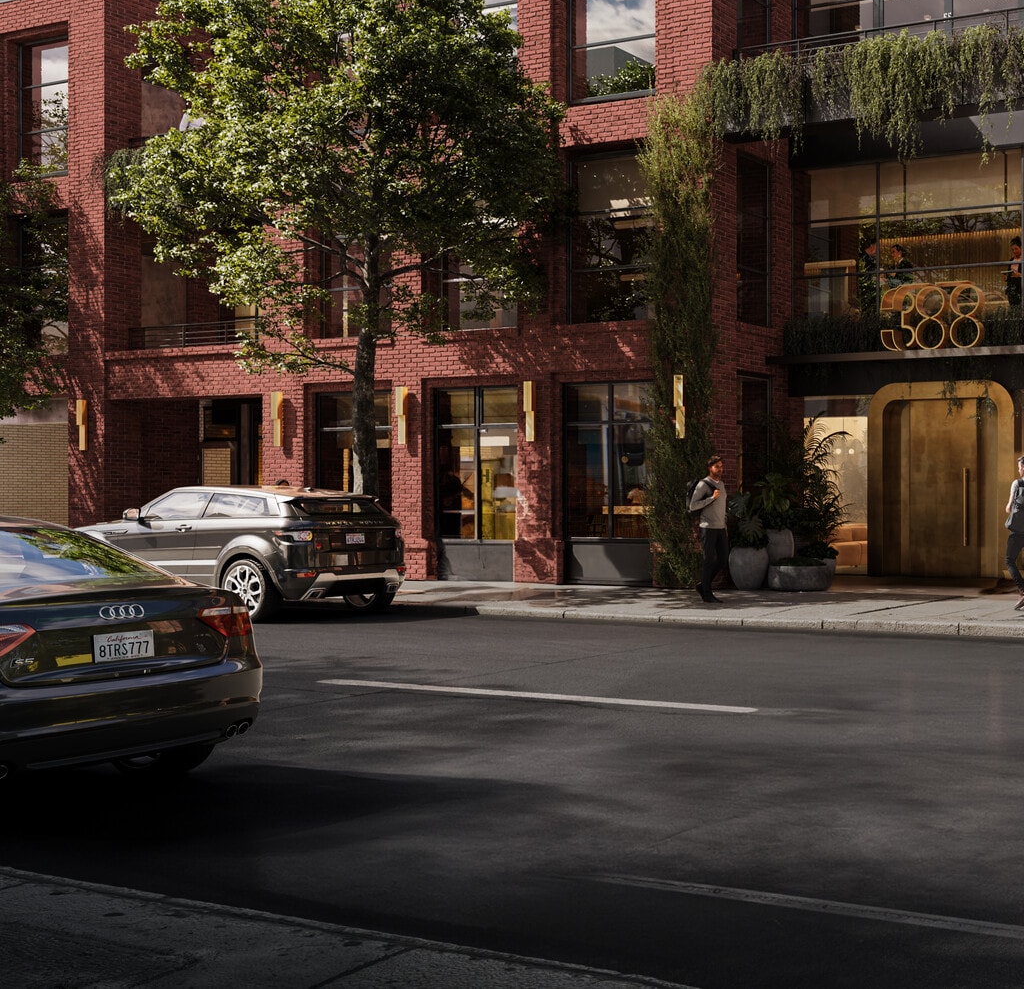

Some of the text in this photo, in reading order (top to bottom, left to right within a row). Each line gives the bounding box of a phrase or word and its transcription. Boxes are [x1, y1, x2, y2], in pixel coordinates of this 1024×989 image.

[880, 280, 983, 351] 388
[106, 634, 143, 643] California
[98, 640, 150, 658] 8TRS777
